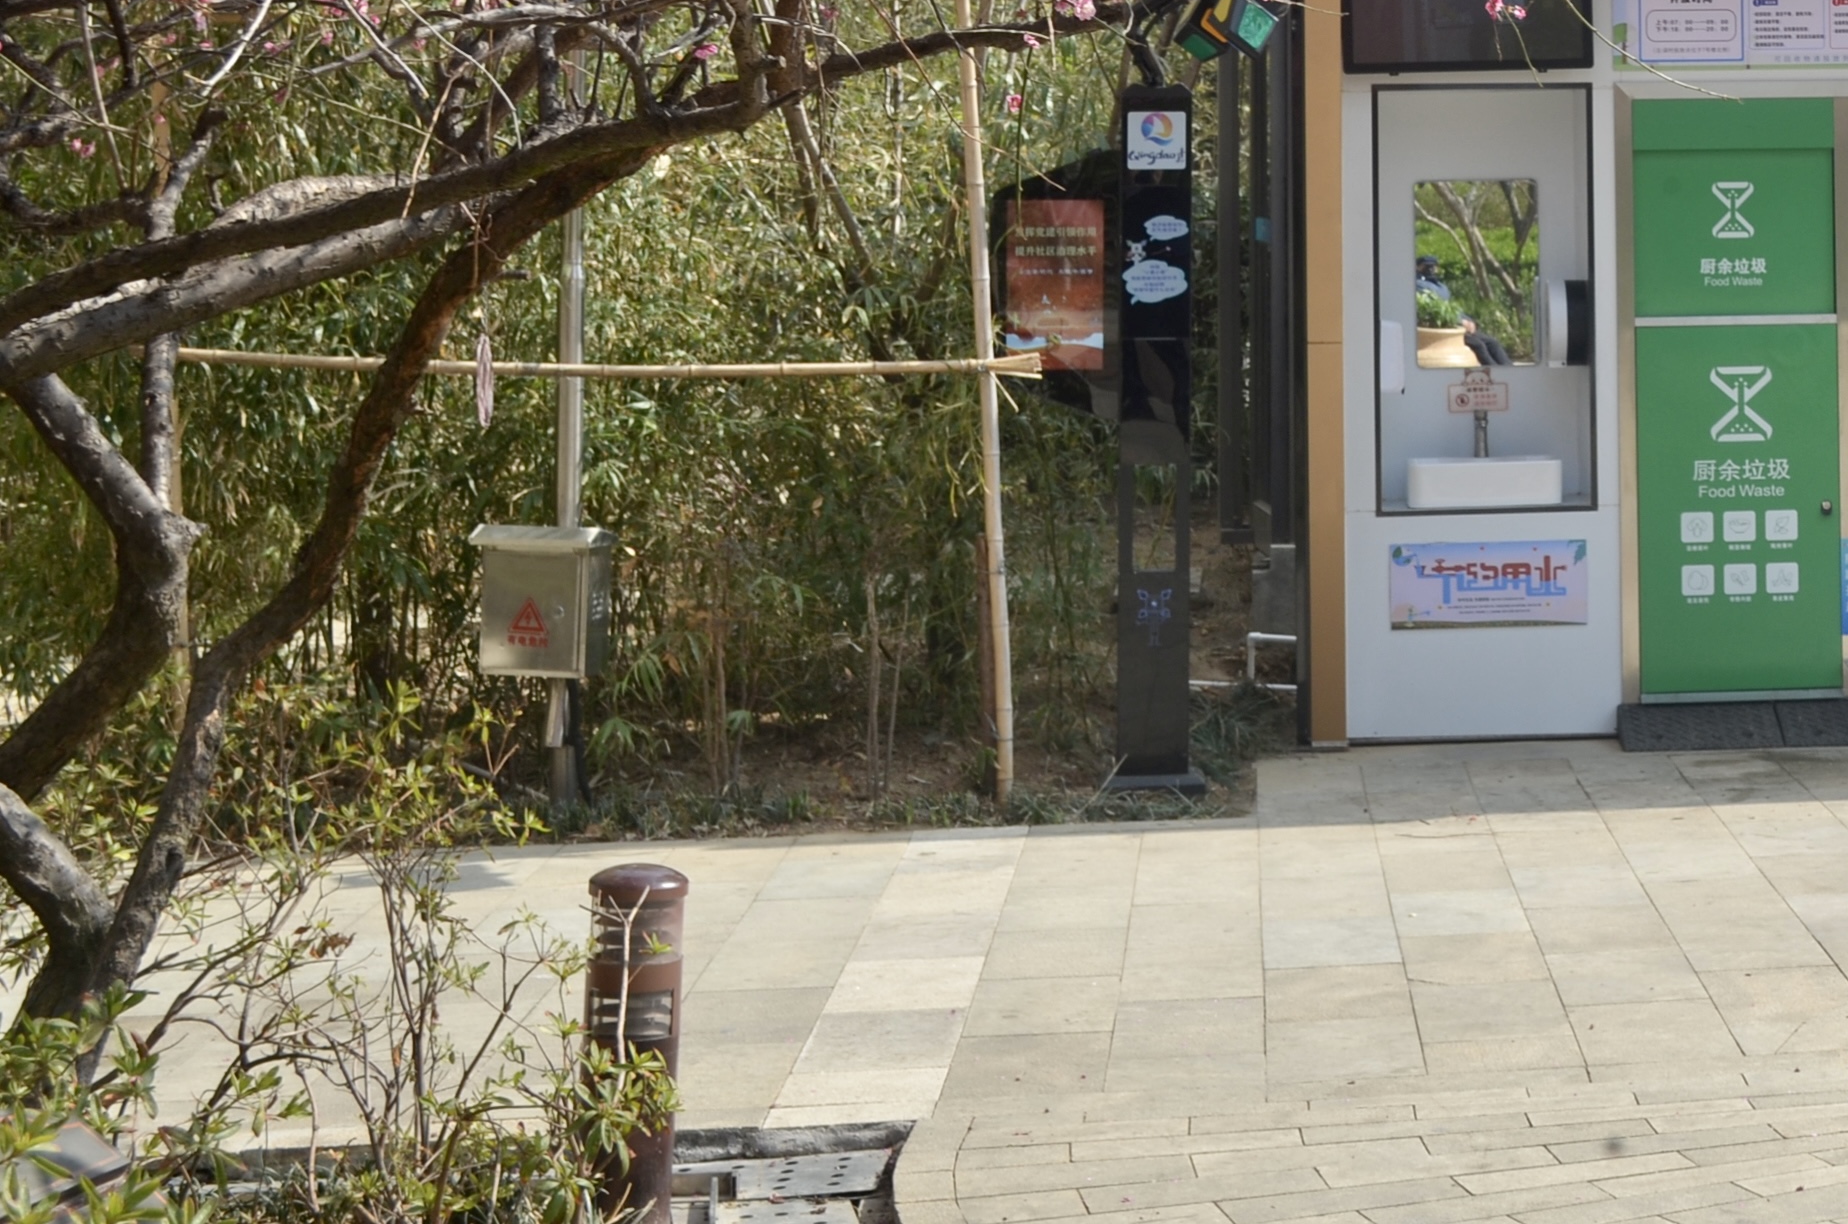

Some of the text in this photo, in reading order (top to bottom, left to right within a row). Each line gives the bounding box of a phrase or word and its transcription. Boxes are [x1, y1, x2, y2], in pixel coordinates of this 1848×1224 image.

[1700, 258, 1767, 274] 厨余垃圾
[1704, 275, 1763, 287] Food Waste
[1693, 459, 1790, 481] 厨余垃圾
[1698, 484, 1785, 498] Food Waste
